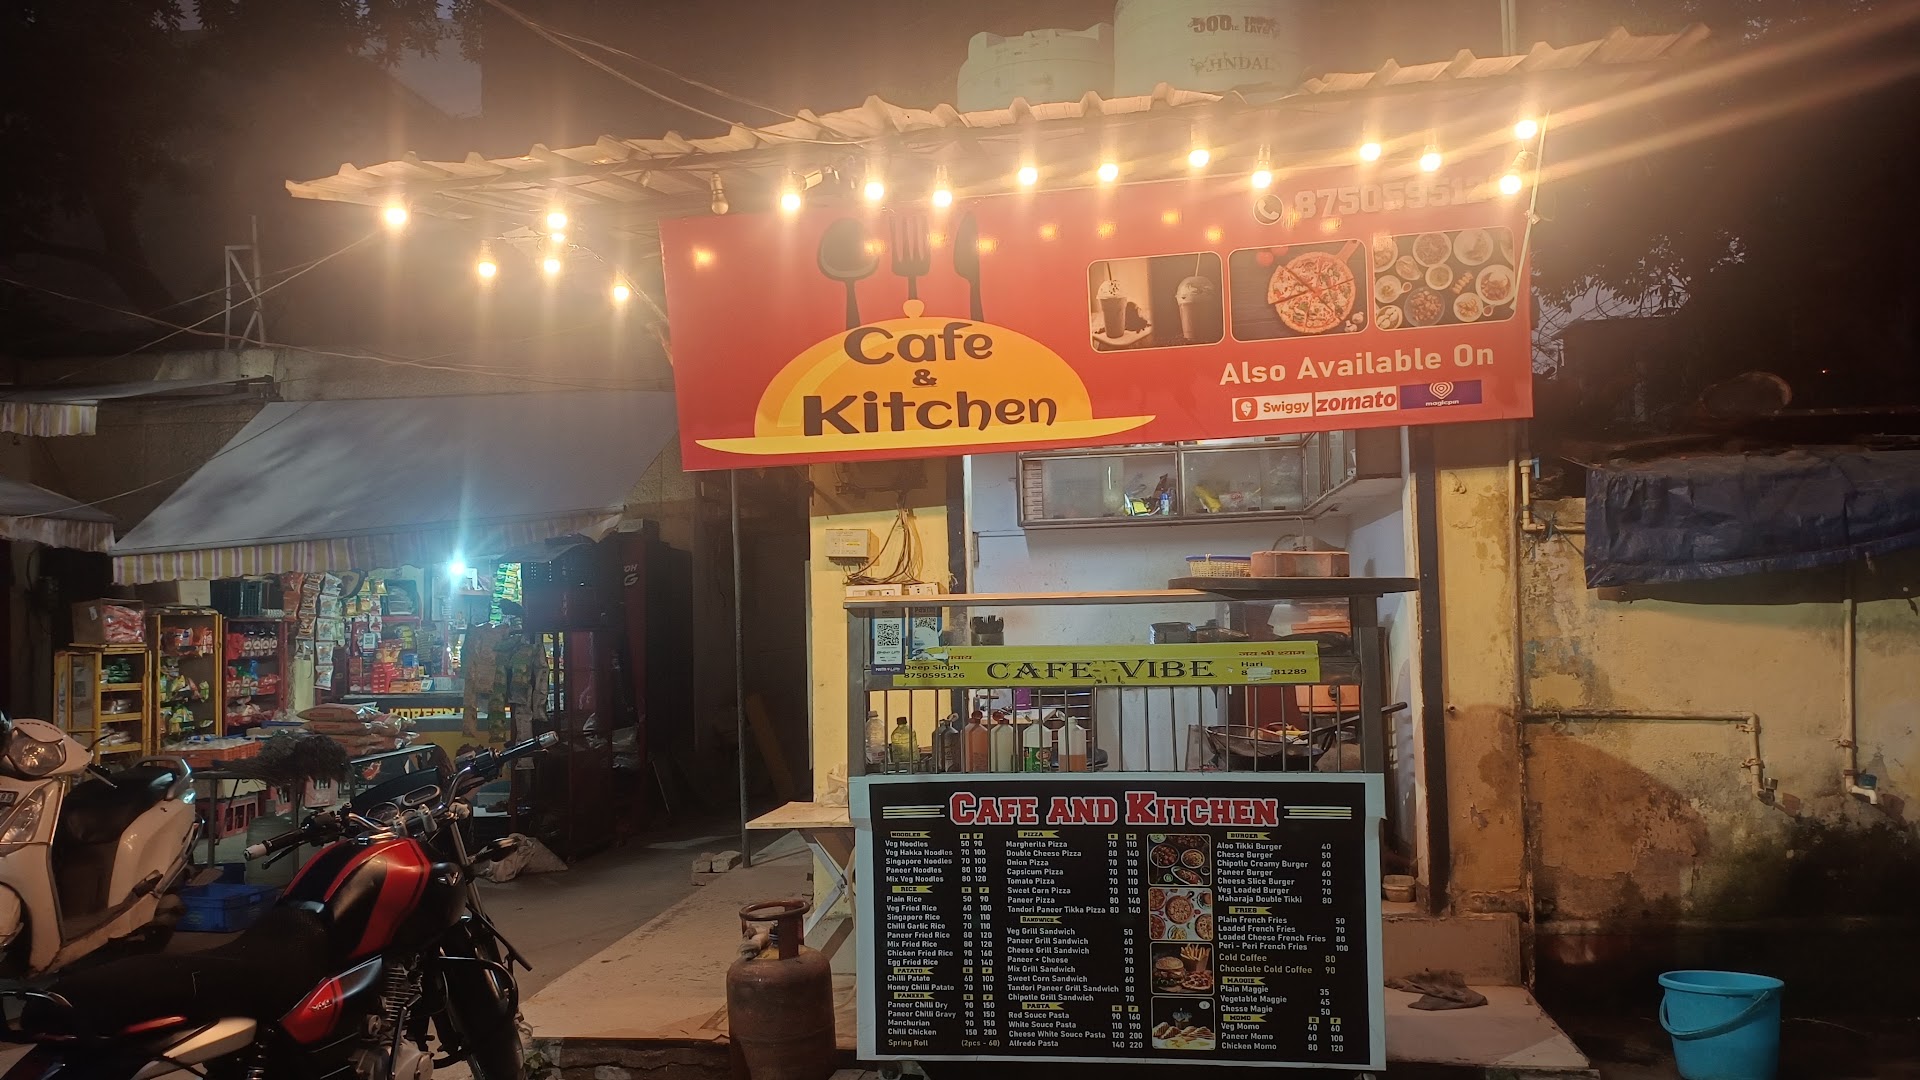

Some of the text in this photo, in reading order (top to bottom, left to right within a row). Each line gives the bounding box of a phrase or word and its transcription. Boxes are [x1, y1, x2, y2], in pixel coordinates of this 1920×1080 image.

[1192, 15, 1232, 33] 500
[844, 322, 992, 364] Cafe
[1220, 344, 1494, 385] Also Available On
[913, 369, 937, 386] &
[1316, 390, 1396, 412] zomato
[1263, 400, 1309, 414] Swiggy
[803, 391, 1057, 436] Kitchen
[904, 664, 930, 672] Deep
[933, 664, 960, 672] Singh
[986, 660, 1218, 680] CAFE VIBE
[950, 790, 1278, 827] CAFE AND KITCHEN
[885, 840, 898, 848] Veg
[1006, 841, 1046, 849] Margherita
[1006, 849, 1031, 857] Double
[1246, 851, 1273, 860] Burger
[885, 858, 922, 866] Singapore
[1217, 860, 1248, 868] Chipotle
[1250, 860, 1280, 868] Creamy
[1282, 860, 1308, 869] Burger
[1007, 868, 1042, 876] Capsicum
[1127, 868, 1138, 876] 110
[900, 876, 913, 884] Veg
[1007, 886, 1030, 894] Sweet
[1109, 887, 1118, 895] 70
[886, 905, 900, 913] Veg
[1268, 916, 1287, 924] Fries
[1006, 927, 1020, 936] Veg
[1124, 928, 1133, 936] 50
[1219, 953, 1336, 963] Cold Coffee 80
[1040, 965, 1076, 973] Sandwich
[1125, 966, 1134, 974] 80
[1219, 964, 1336, 974] Chocolate Cold Coffee 90
[1241, 985, 1269, 994] Maggie
[1008, 993, 1038, 1002] Chipotle
[1058, 994, 1094, 1002] Sandwich
[1220, 995, 1330, 1006] Vegetable Maggie 45
[1221, 1022, 1235, 1031] Veg
[888, 1039, 912, 1047] Spring
